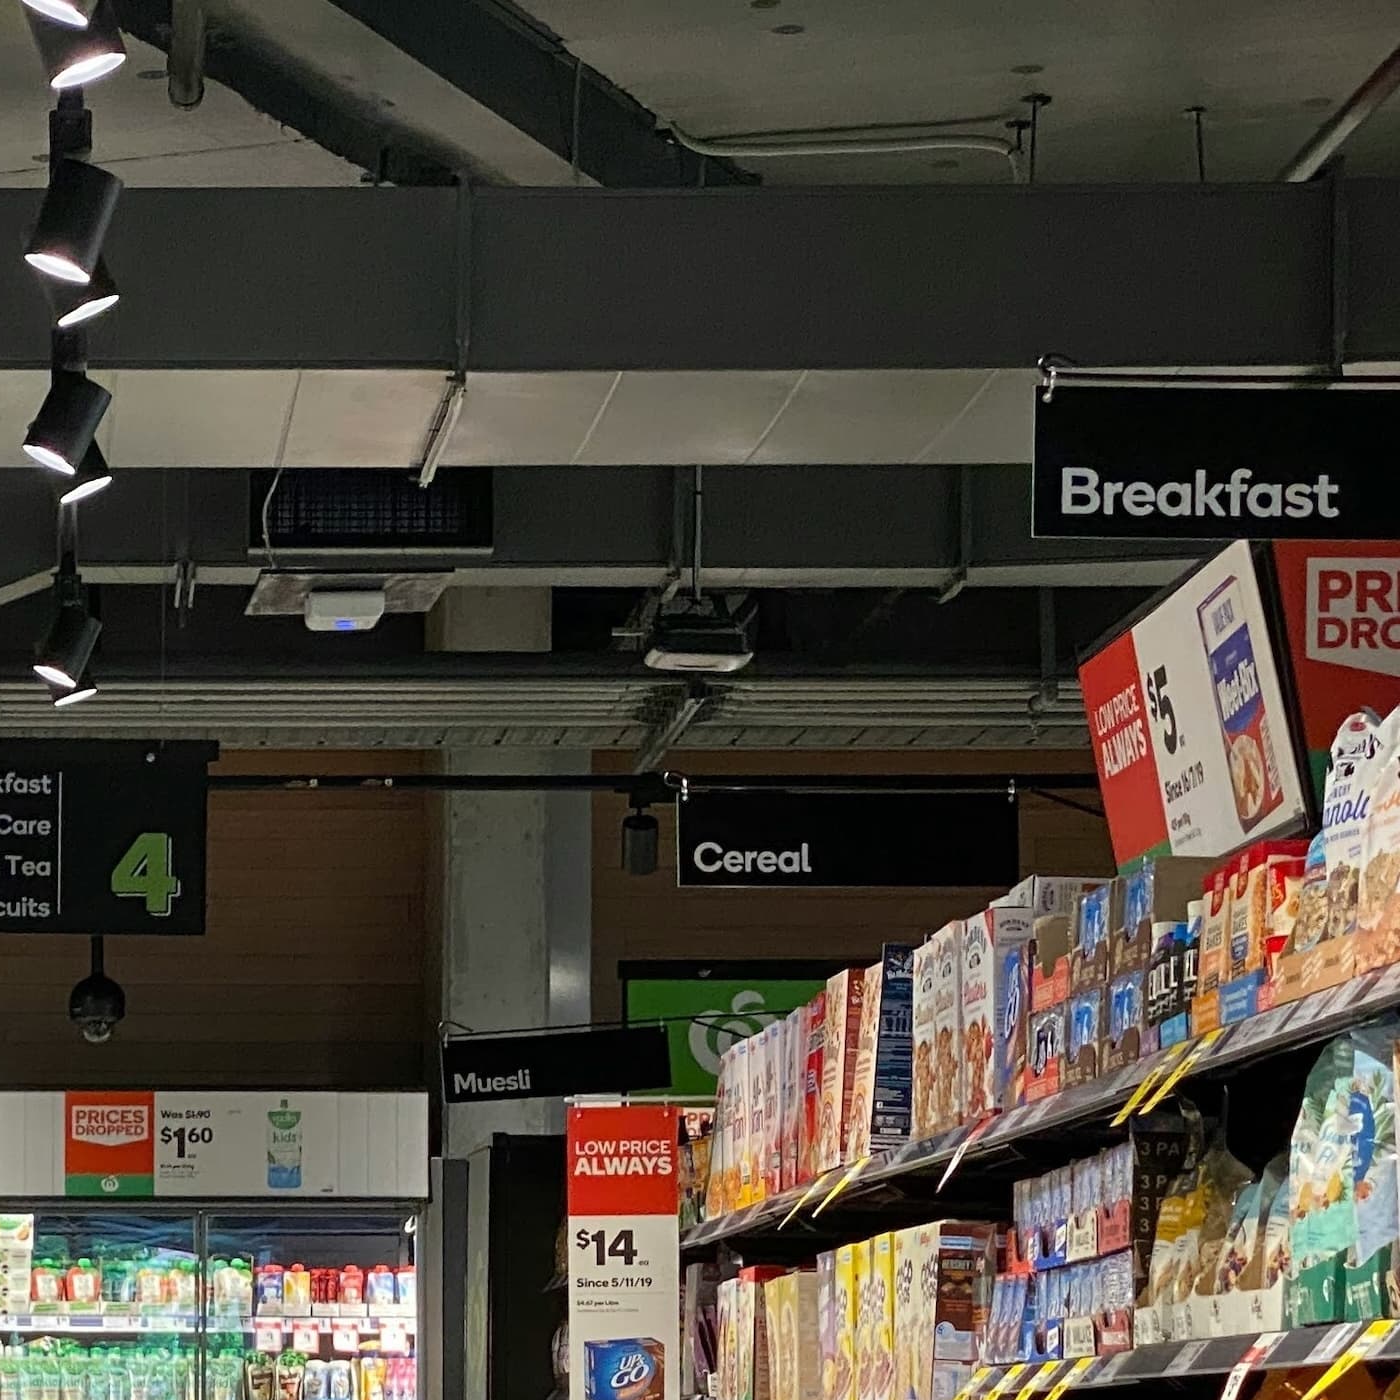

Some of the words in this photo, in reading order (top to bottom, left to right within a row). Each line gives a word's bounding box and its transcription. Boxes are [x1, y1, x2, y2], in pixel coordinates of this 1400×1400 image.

[1060, 466, 1340, 519] Breakfast
[1094, 701, 1115, 736] LOW
[1114, 683, 1140, 724] PRICE
[1101, 719, 1147, 779] ALWAYS
[1165, 774, 1183, 804] Since
[5, 857, 51, 877] Tea
[694, 842, 812, 873] Cereal
[111, 832, 180, 917] 4
[454, 1069, 531, 1094] Muesli
[75, 1110, 145, 1124] PRICES
[160, 1110, 184, 1119] Was
[75, 1125, 145, 1137] DROPPED
[272, 1131, 297, 1144] kids
[574, 1141, 618, 1156] LOW
[620, 1140, 671, 1155] PRICE
[574, 1157, 673, 1176] ALWAYS
[576, 1228, 638, 1266] $14
[576, 1278, 609, 1288] Since
[611, 1277, 653, 1289] 5/11/19
[610, 1363, 650, 1391] GO
